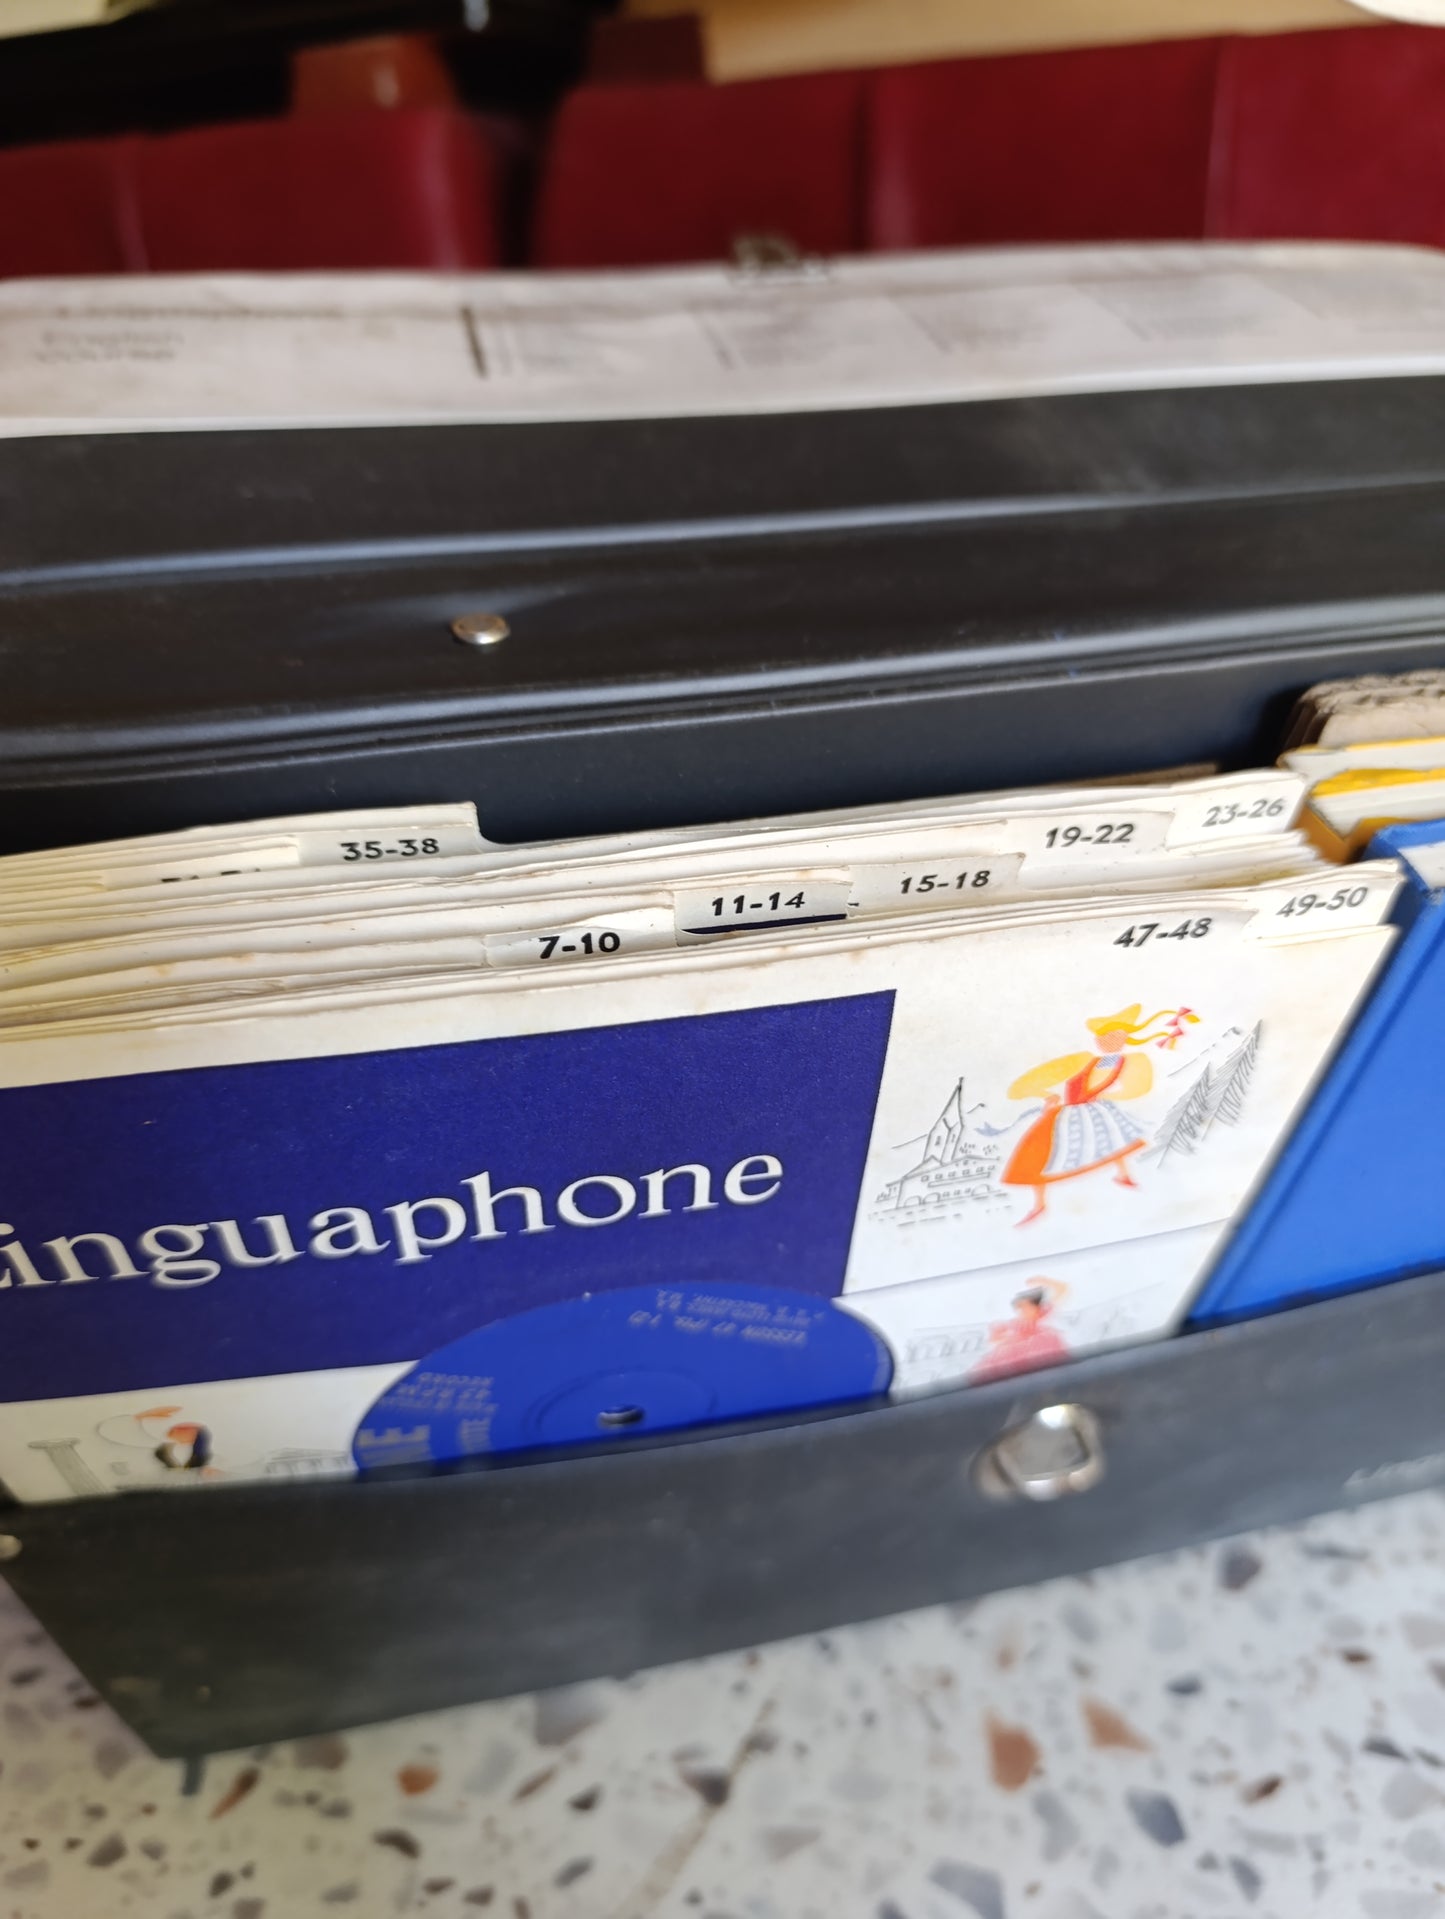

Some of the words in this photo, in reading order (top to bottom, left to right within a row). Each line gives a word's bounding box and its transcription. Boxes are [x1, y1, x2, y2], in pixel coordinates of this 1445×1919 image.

[1201, 797, 1285, 828] 23-26
[340, 837, 441, 862] 35-38
[1045, 823, 1136, 849] 19-22
[900, 870, 991, 895] 15-18
[711, 892, 806, 917] 11-14
[1276, 886, 1369, 918] 49-50
[538, 930, 621, 960] 7-10
[1113, 917, 1213, 948] 47-48
